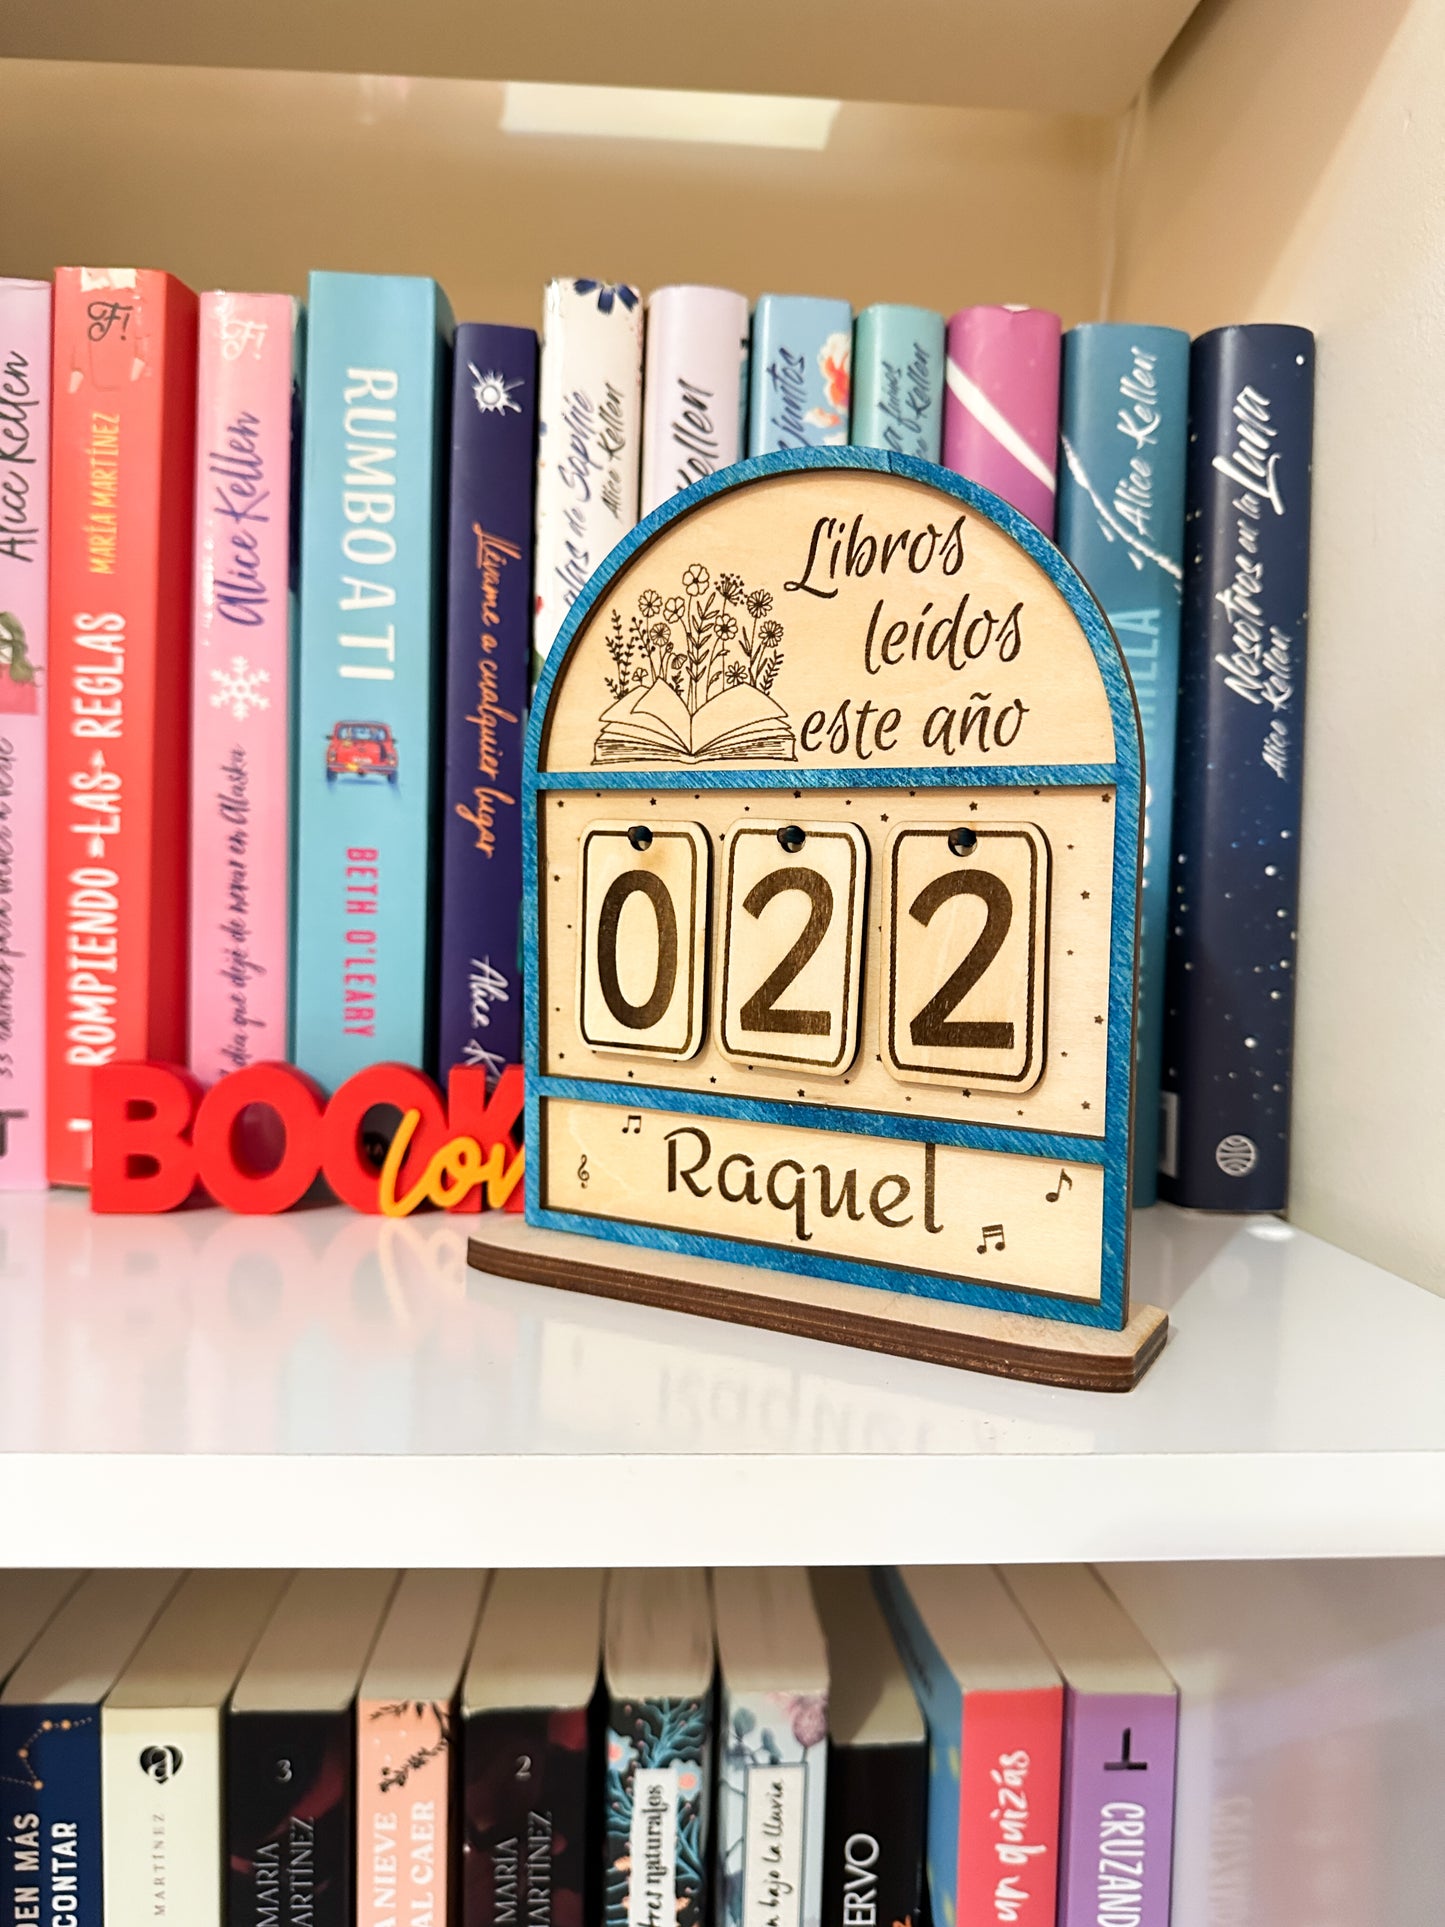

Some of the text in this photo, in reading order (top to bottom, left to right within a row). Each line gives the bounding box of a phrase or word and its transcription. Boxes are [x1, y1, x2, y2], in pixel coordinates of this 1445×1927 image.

[904, 341, 932, 419] Kellen
[556, 390, 604, 504] Sophie
[597, 381, 626, 521] Alice Kellen
[1112, 345, 1161, 538] Alice Kellen
[1212, 384, 1285, 516] Luna
[82, 411, 121, 575] MARÍA MARTÍNEZ
[208, 410, 271, 627] Alice Kellen
[338, 366, 399, 682] RUMBO A TI
[563, 506, 587, 540] de
[472, 520, 523, 628] Llévame
[784, 513, 967, 598] Libros
[71, 610, 127, 739] REGLAS
[865, 593, 1025, 675] leídos
[1215, 553, 1265, 705] Nosotros
[465, 657, 518, 778] cualquier
[800, 691, 1030, 760] este año
[1259, 626, 1294, 783] Alice Kellen
[216, 743, 250, 826] Alaska
[455, 785, 516, 860] lugar
[227, 829, 249, 857] en
[65, 866, 120, 1067] ROMPIENDO
[218, 918, 251, 943] de
[342, 847, 379, 1039] BETH O'LEARY
[467, 954, 509, 1029] Alice
[663, 1125, 944, 1241] Raquel
[275, 1759, 293, 1784] 3
[515, 1755, 532, 1782] 2
[760, 1779, 785, 1839] lluvia
[6, 1812, 40, 1872] MÁS
[50, 1821, 79, 1927] CONTAR
[251, 1841, 281, 1927] MARÍA
[373, 1811, 398, 1910] NIEVE
[410, 1799, 436, 1886] CAER
[490, 1836, 519, 1924] MARÍA
[523, 1810, 553, 1927] ARTÍNEZ
[641, 1784, 670, 1885] naturales
[760, 1844, 783, 1863] la
[988, 1749, 1047, 1922] un quizás
[757, 1870, 794, 1908] bajo
